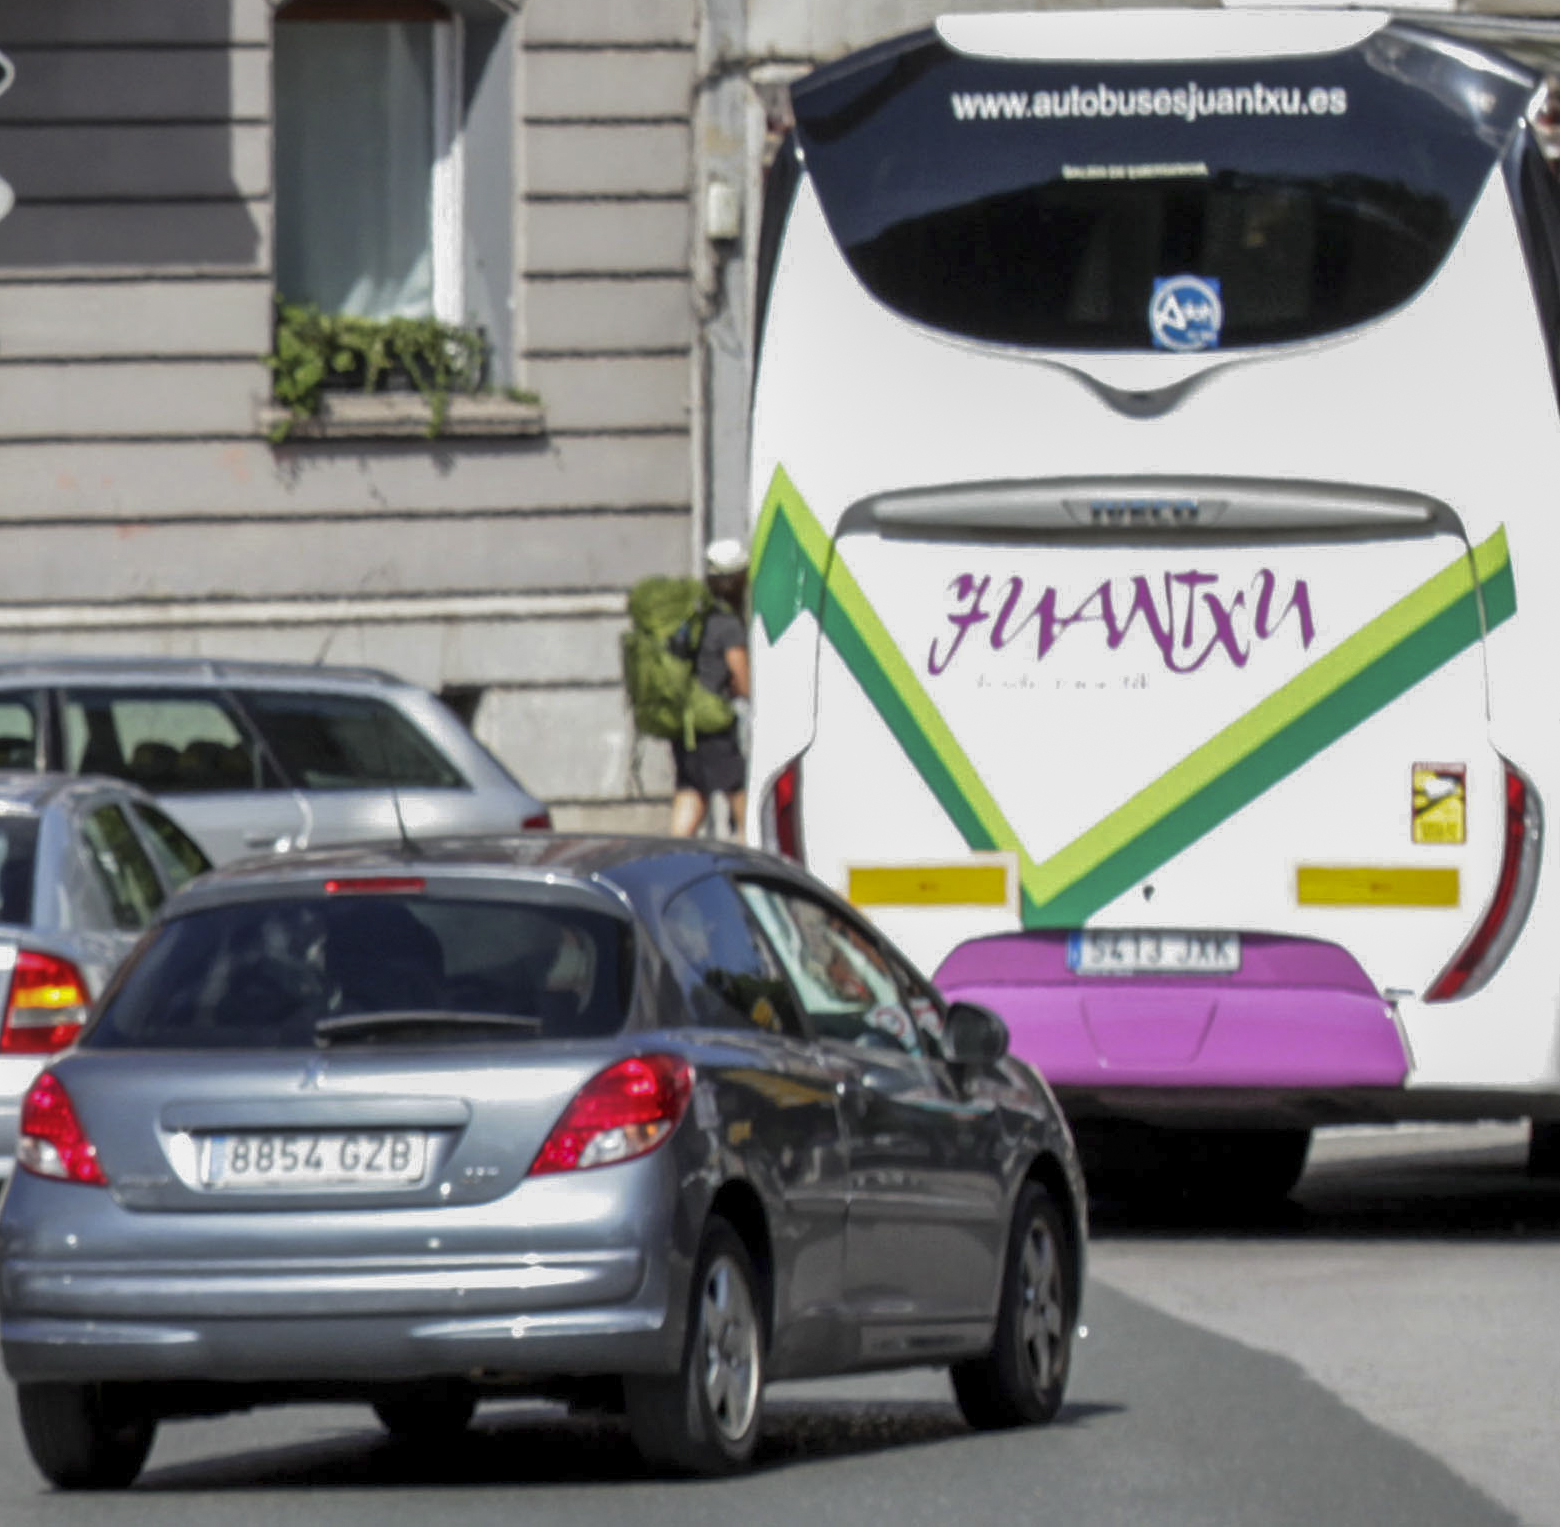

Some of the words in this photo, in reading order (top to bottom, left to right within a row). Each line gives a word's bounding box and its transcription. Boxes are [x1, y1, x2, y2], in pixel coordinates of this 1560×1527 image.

[951, 82, 1348, 123] www.autobusesjuantxu.es
[230, 1136, 323, 1175] 8854
[339, 1135, 413, 1172] GZB
